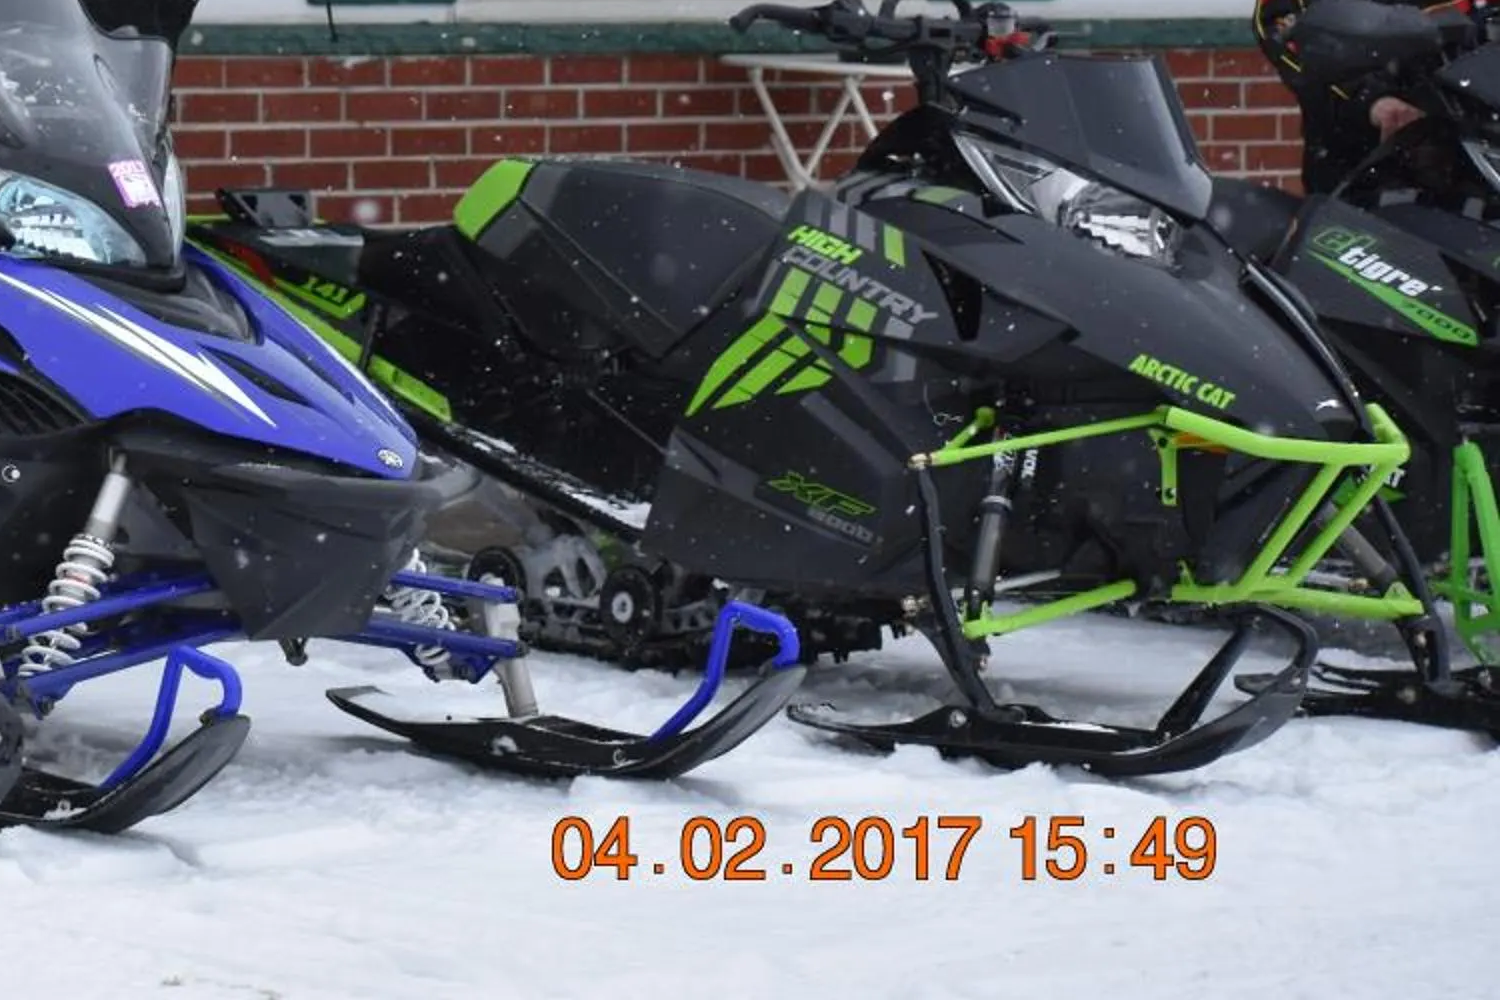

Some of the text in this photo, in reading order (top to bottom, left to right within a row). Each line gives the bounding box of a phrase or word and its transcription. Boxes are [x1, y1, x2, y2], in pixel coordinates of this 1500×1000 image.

[787, 225, 863, 265] HIGH
[1338, 246, 1430, 297] tigre
[780, 244, 940, 325] COUNTRY
[1128, 353, 1236, 410] ARCTIC CAT
